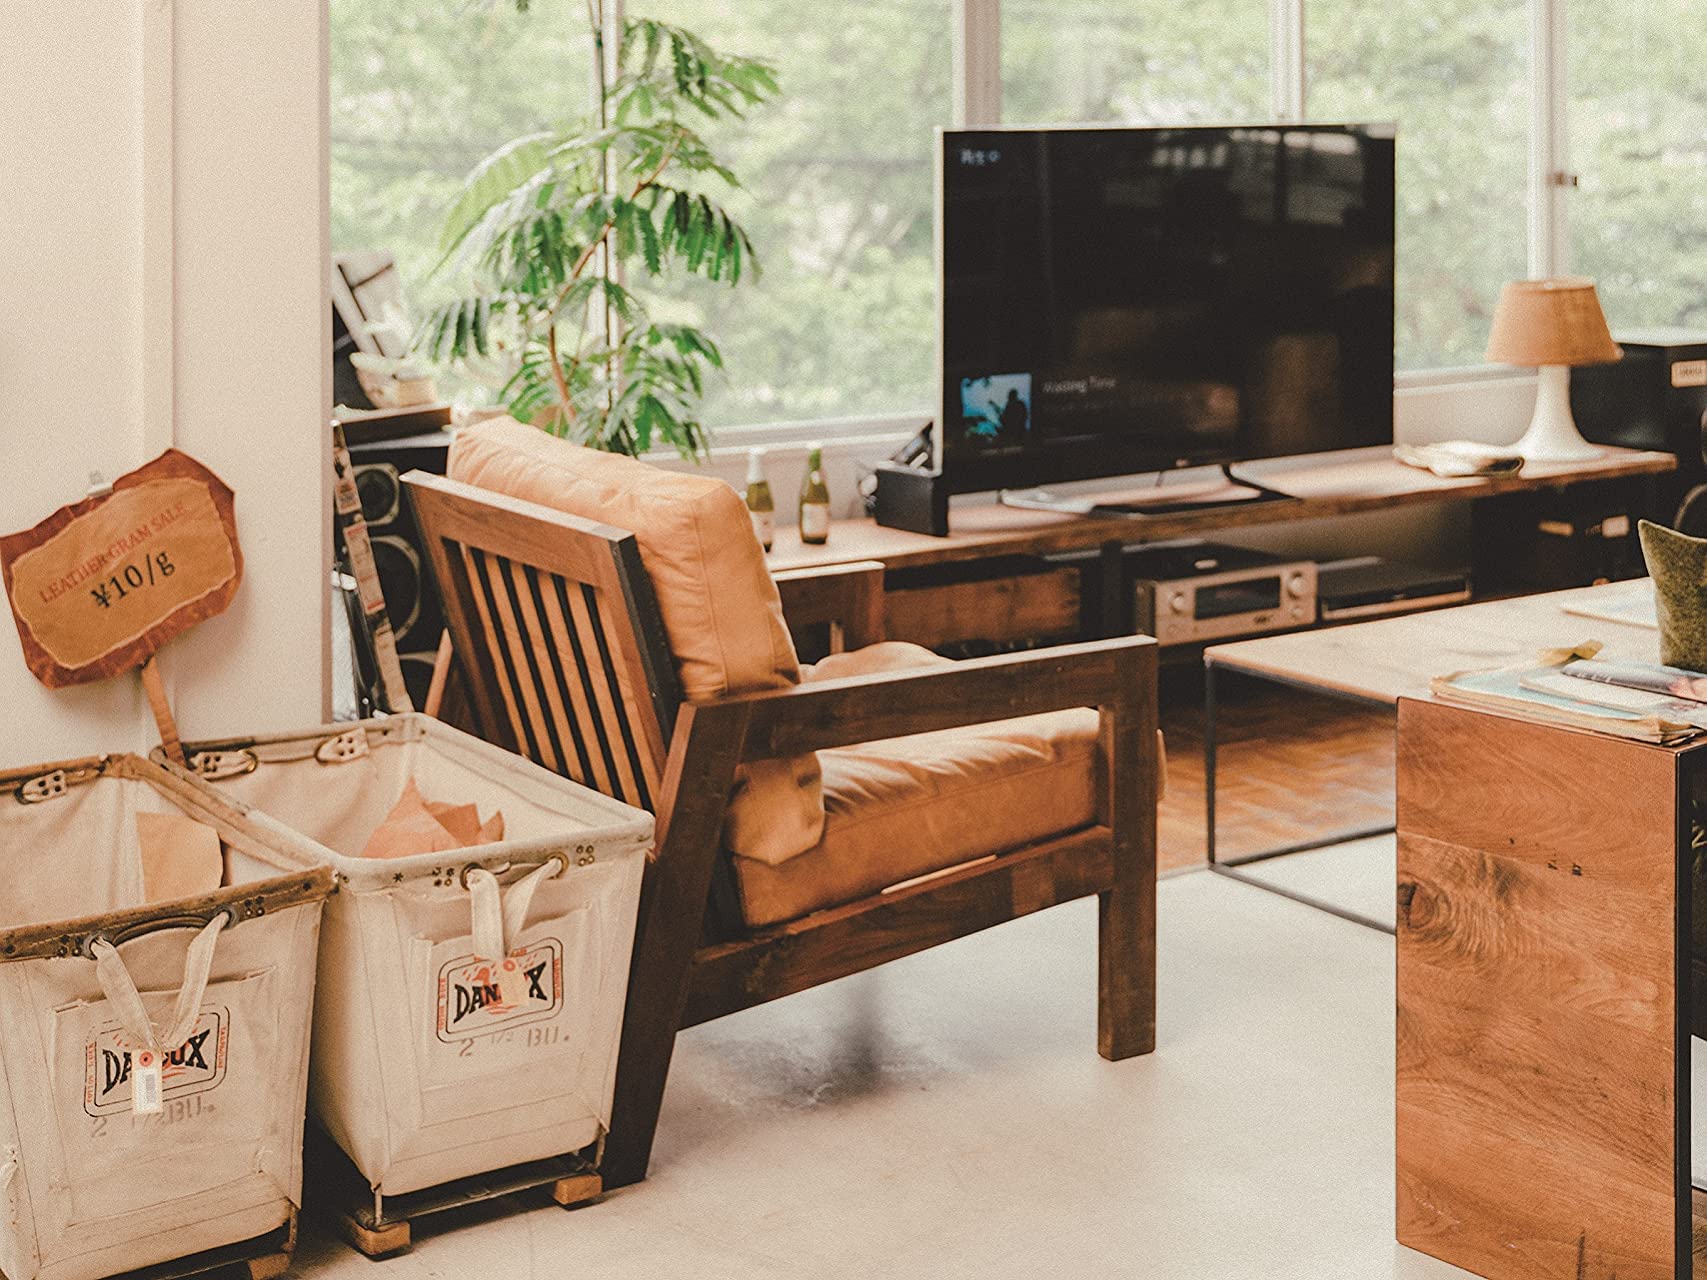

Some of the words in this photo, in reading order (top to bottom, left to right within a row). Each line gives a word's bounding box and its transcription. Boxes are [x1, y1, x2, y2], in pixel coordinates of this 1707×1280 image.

[39, 553, 107, 604] LEATHER
[108, 526, 153, 560] GRAM
[152, 504, 188, 533] SALE
[90, 551, 175, 609] ¥10/g
[453, 961, 548, 1024] DANX
[102, 1029, 210, 1096] DAUX
